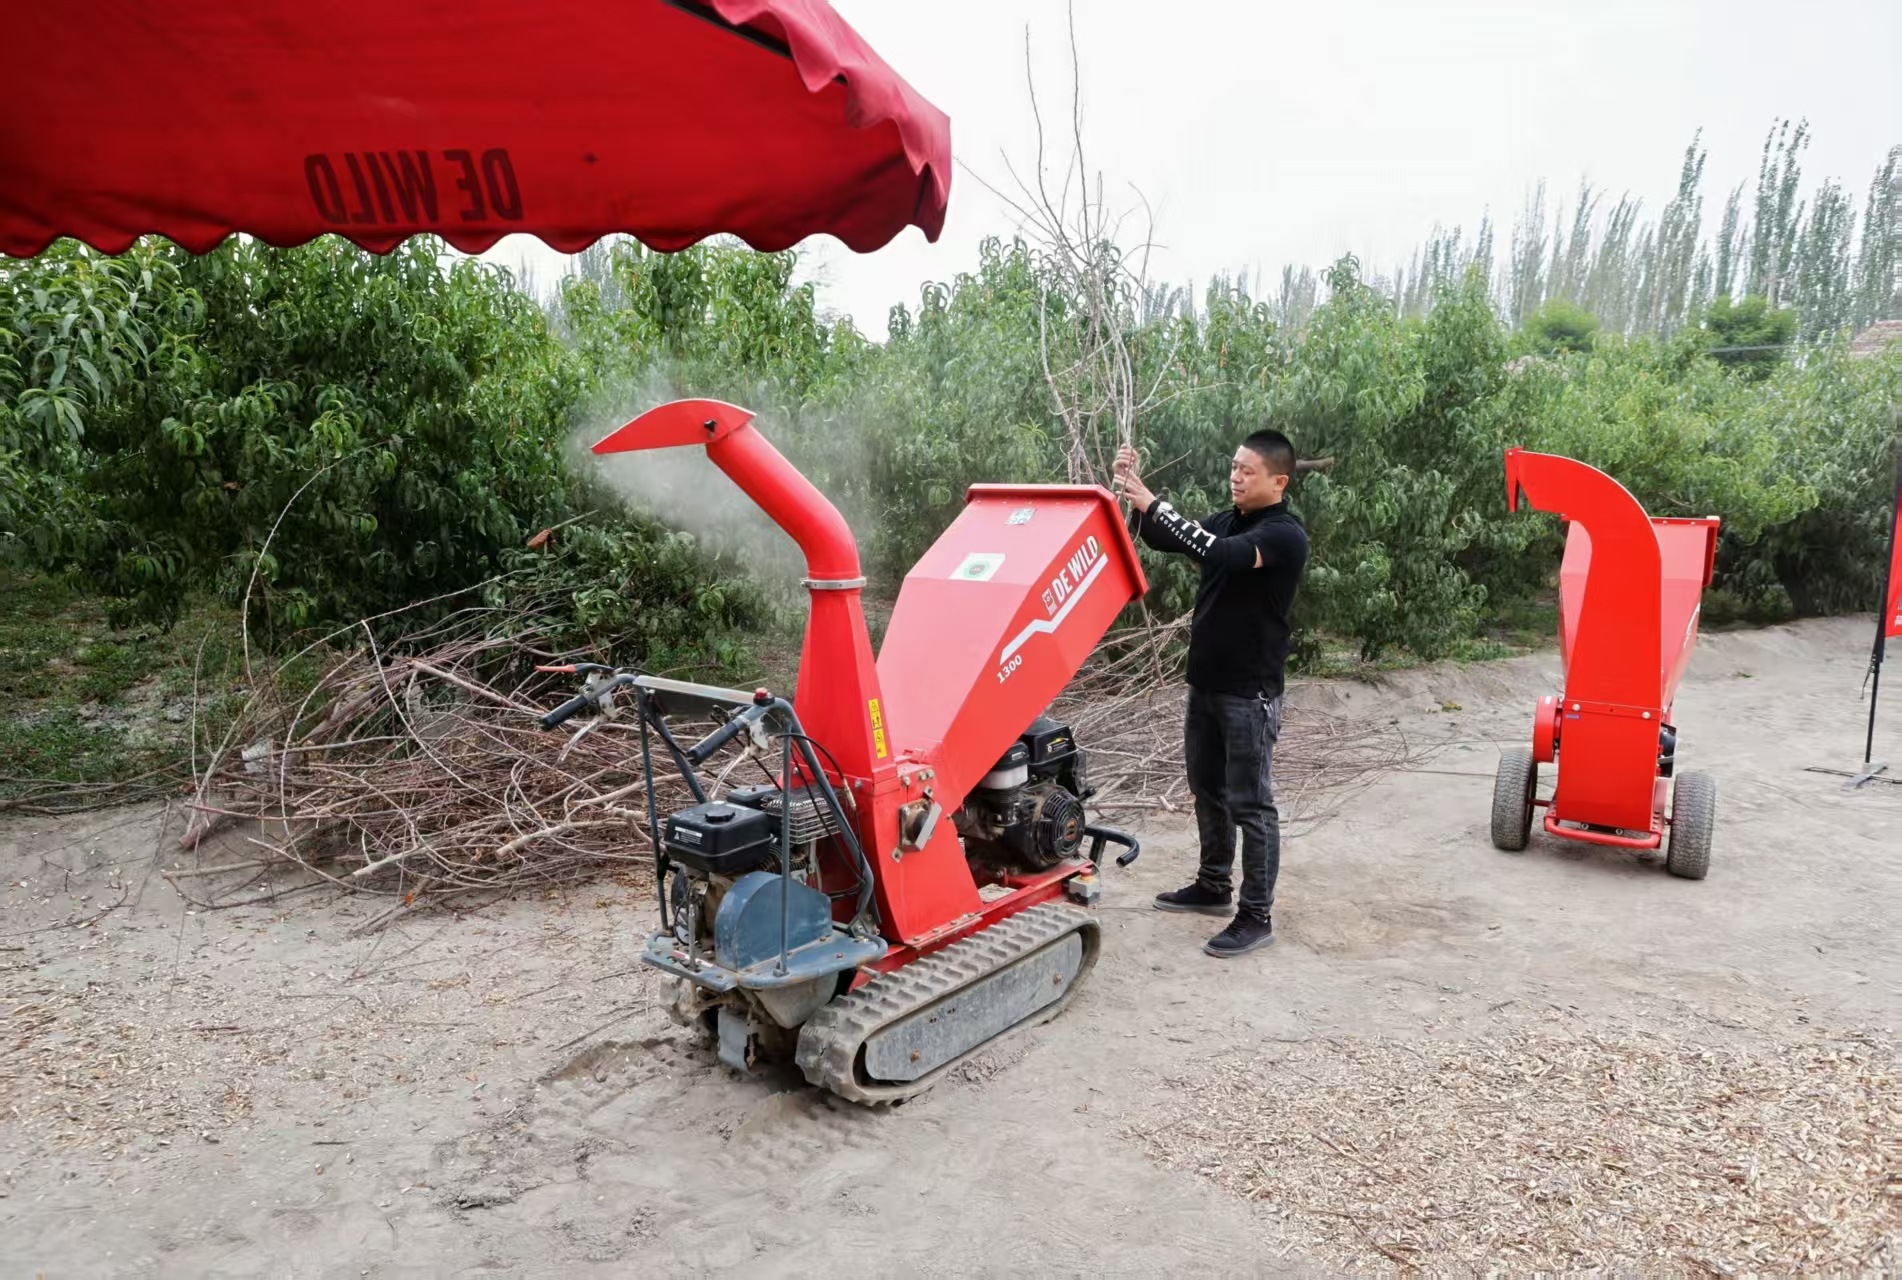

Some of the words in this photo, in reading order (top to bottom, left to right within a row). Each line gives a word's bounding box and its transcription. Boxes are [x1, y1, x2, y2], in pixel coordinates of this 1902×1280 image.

[1160, 515, 1206, 557] ROFESSIONAL
[1052, 570, 1074, 604] DE
[1067, 535, 1099, 583] WILD
[996, 654, 1023, 684] 1300
